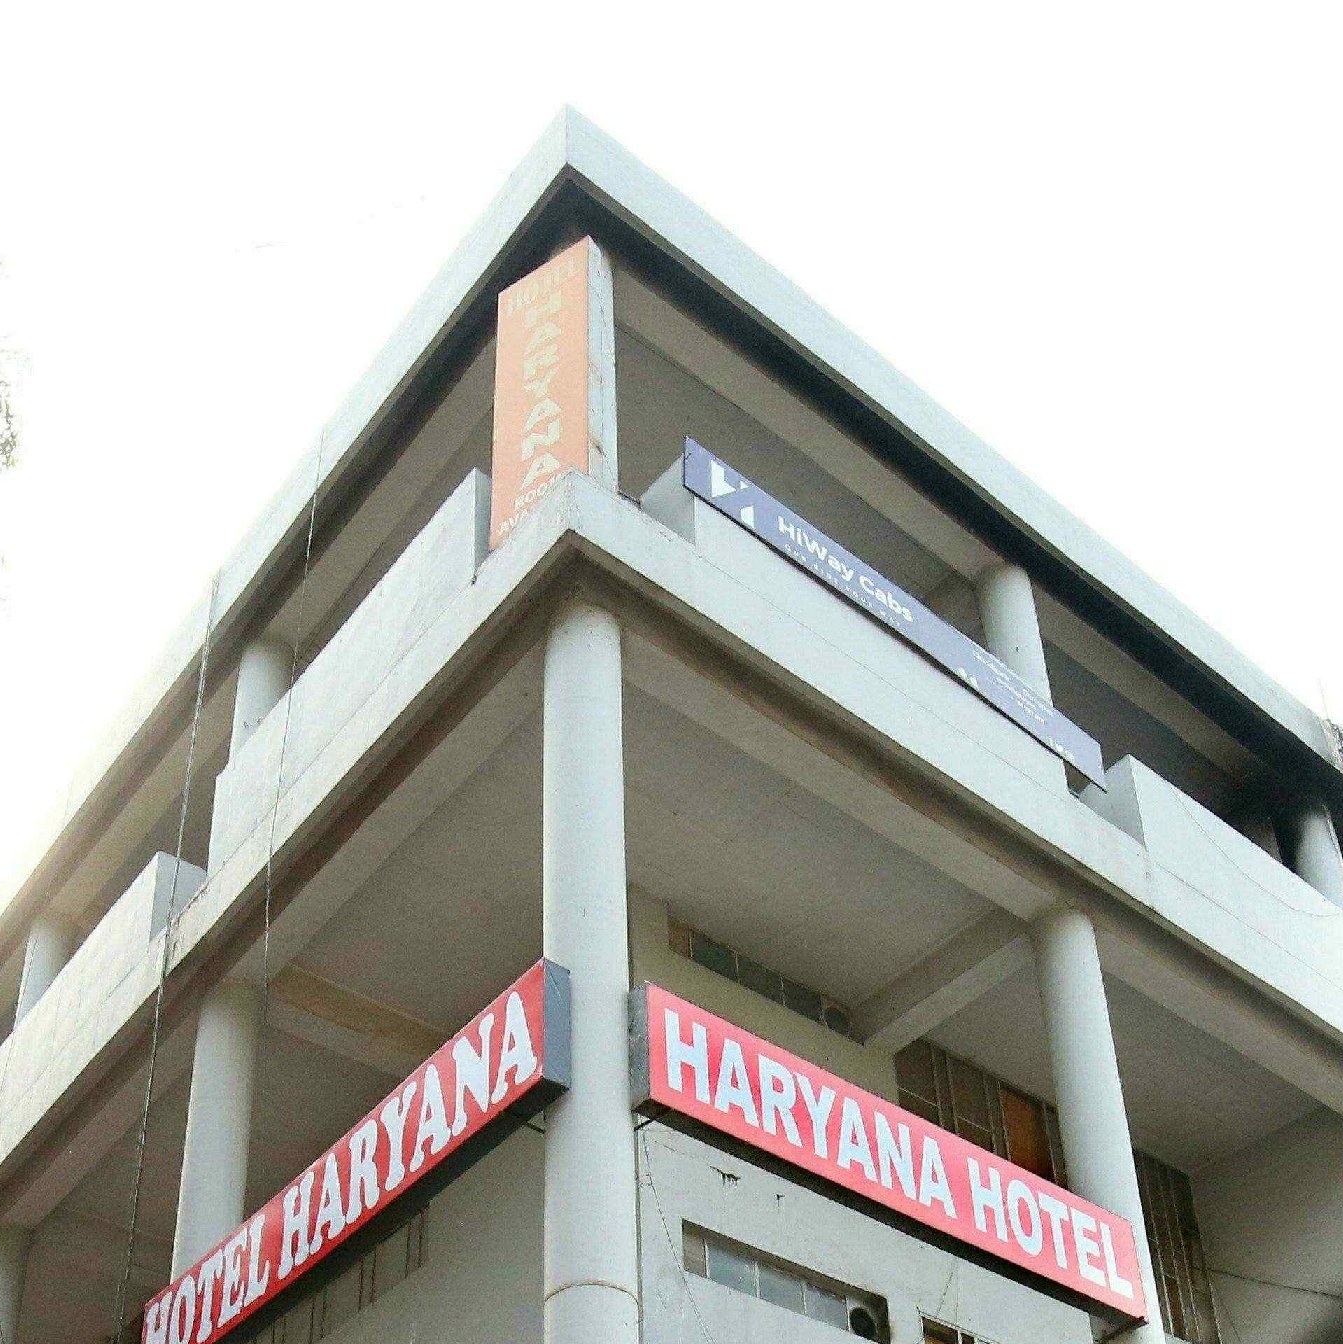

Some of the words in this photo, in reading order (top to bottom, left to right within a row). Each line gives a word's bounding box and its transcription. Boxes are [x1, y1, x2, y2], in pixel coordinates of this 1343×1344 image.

[777, 515, 854, 582] HiWay
[859, 575, 914, 623] Cabs
[278, 990, 538, 1280] HARYANA
[665, 1007, 958, 1219] HARYANA
[967, 1157, 1134, 1300] HOTEL
